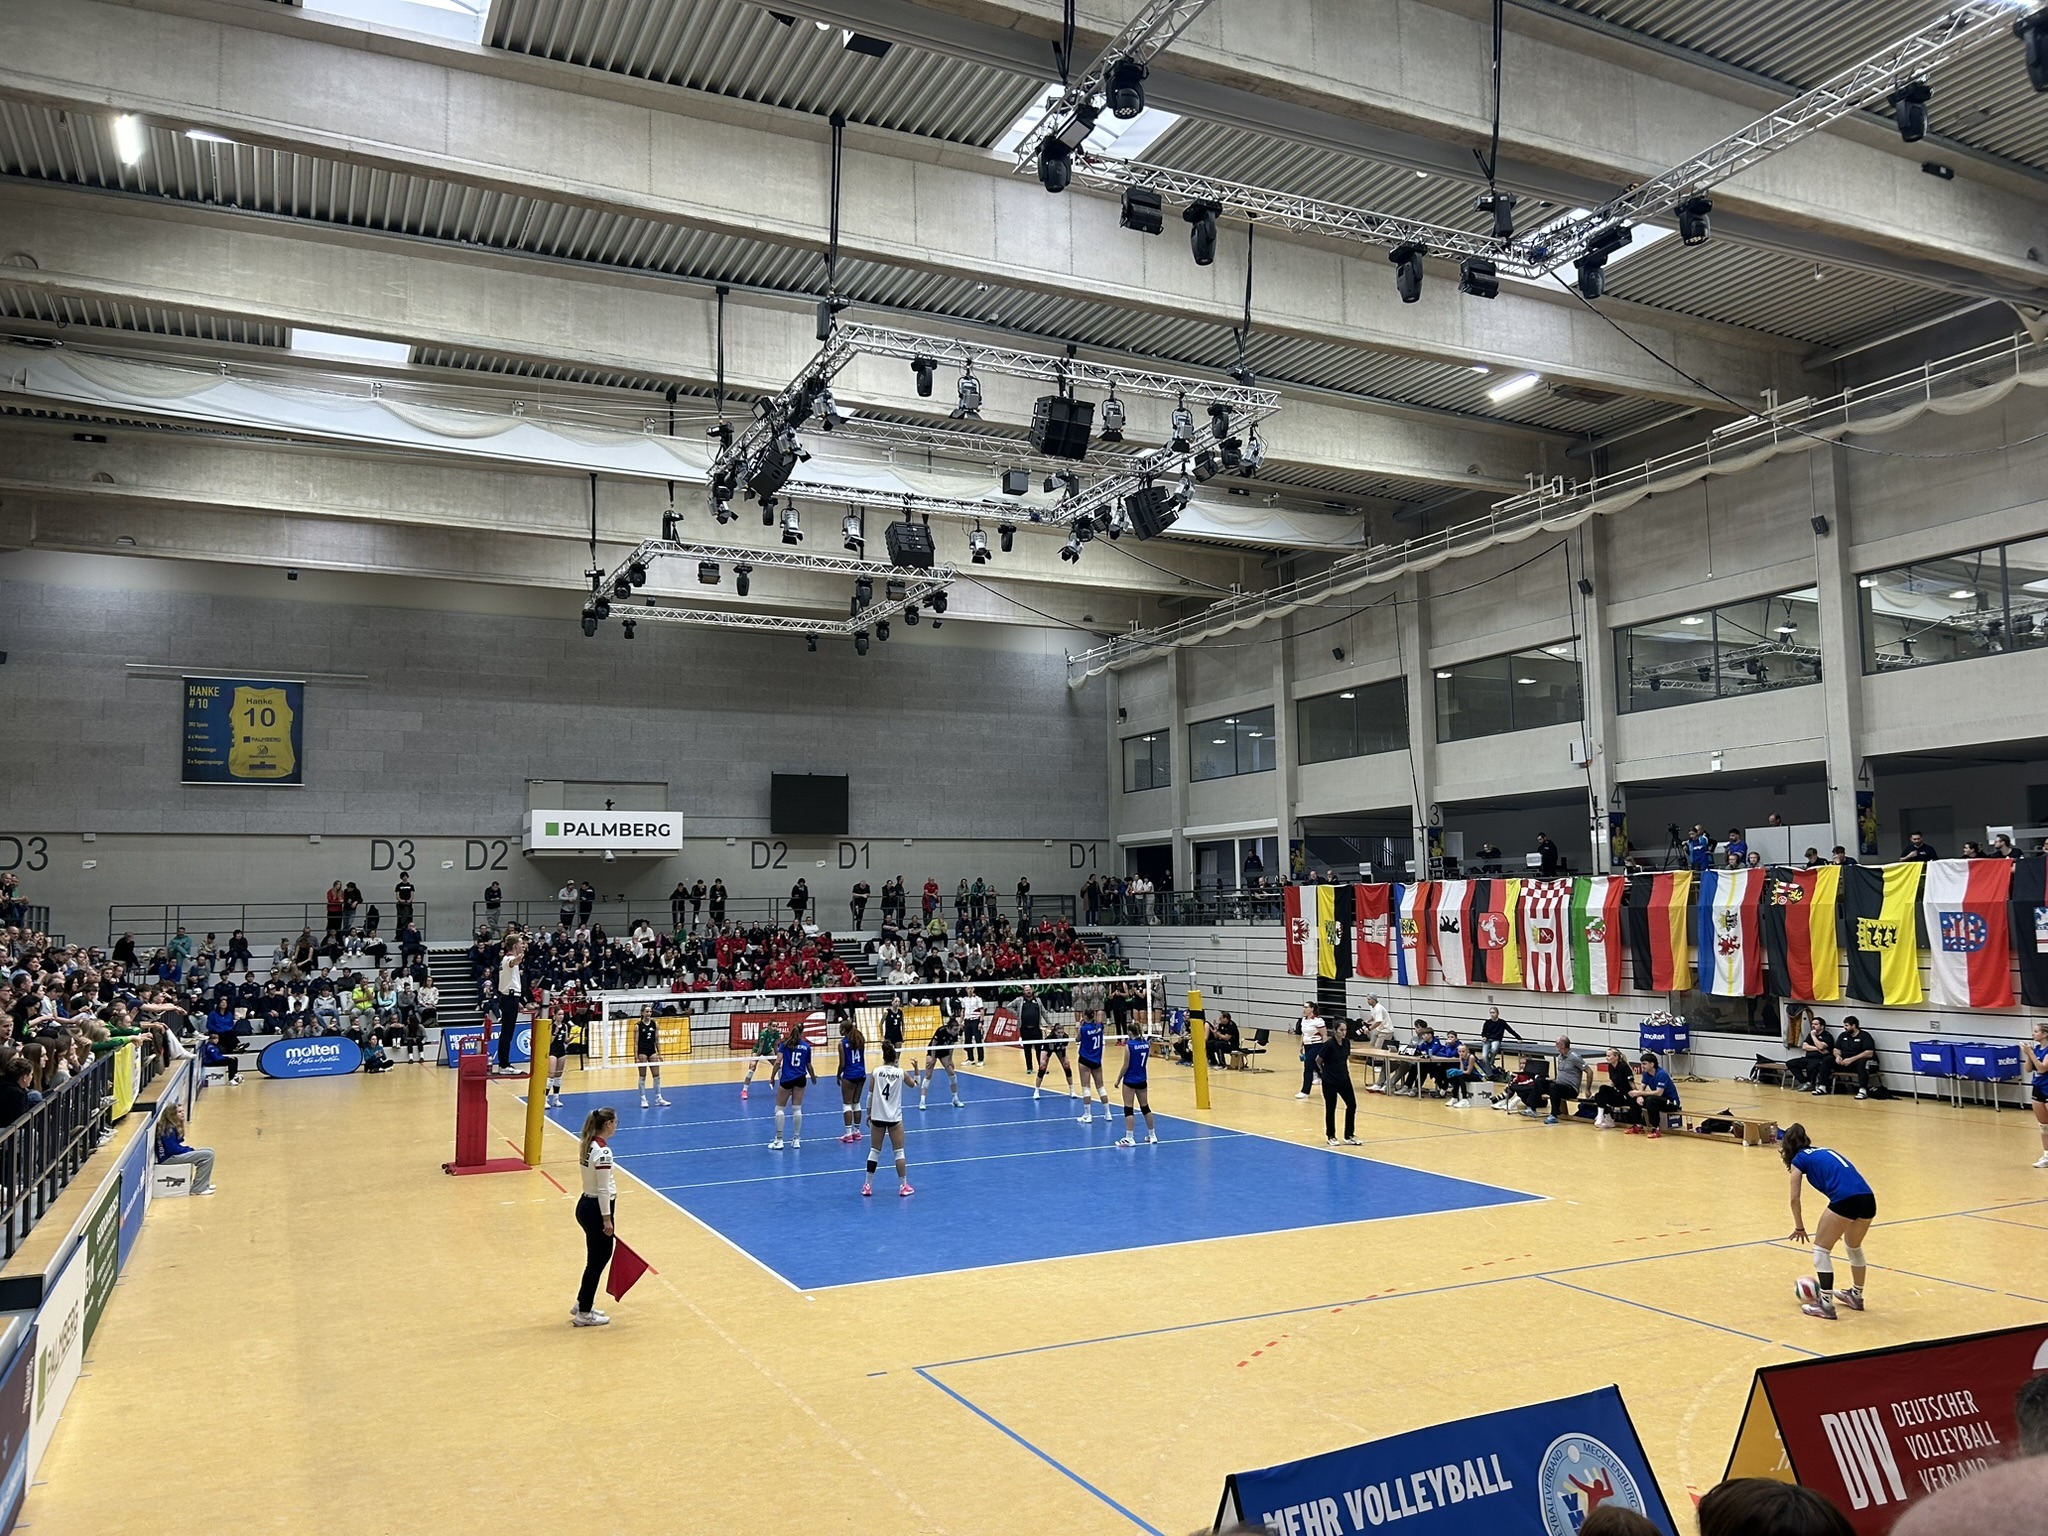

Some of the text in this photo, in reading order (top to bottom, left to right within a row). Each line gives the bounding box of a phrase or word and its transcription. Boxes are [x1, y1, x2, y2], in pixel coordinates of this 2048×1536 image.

[189, 686, 220, 697] HANKE
[188, 699, 208, 709] # 10
[244, 708, 276, 727] 10
[1858, 757, 1869, 788] 4
[1611, 784, 1621, 810] 4
[1430, 804, 1440, 826] 3
[563, 822, 671, 837] PALMBERG
[0, 836, 48, 871] D3
[371, 839, 416, 871] D3
[465, 840, 508, 871] D2
[751, 841, 788, 869] D2
[839, 842, 869, 869] D1
[1070, 843, 1097, 868] D1
[741, 1022, 760, 1040] DVV
[285, 1044, 340, 1059] molten
[1092, 1036, 1101, 1050] 21
[791, 1051, 802, 1067] 15
[851, 1050, 861, 1064] 14
[1140, 1052, 1147, 1067] 7
[881, 1083, 891, 1101] 4
[1891, 1390, 1980, 1428] DEUTSCHER
[1904, 1420, 2001, 1461] VOLLEYBALL
[1820, 1406, 1908, 1510] DVV
[1262, 1453, 1513, 1536] MEHR VOLLEYBALL
